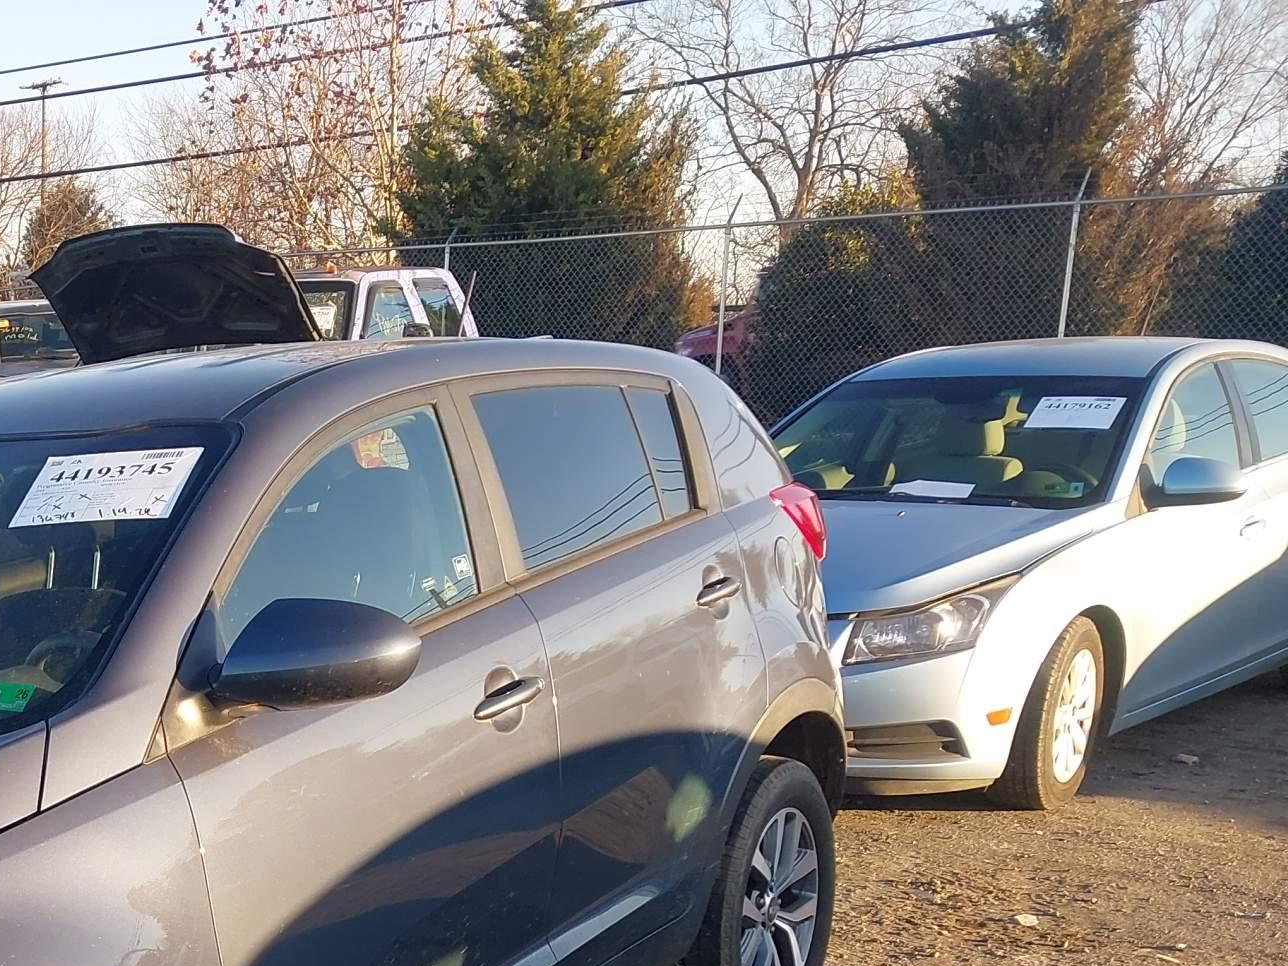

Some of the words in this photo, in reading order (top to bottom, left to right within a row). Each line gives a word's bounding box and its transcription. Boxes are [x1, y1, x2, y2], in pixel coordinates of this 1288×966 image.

[1044, 402, 1112, 410] 44179162
[50, 462, 175, 483] 44193745
[15, 689, 30, 699] 26
